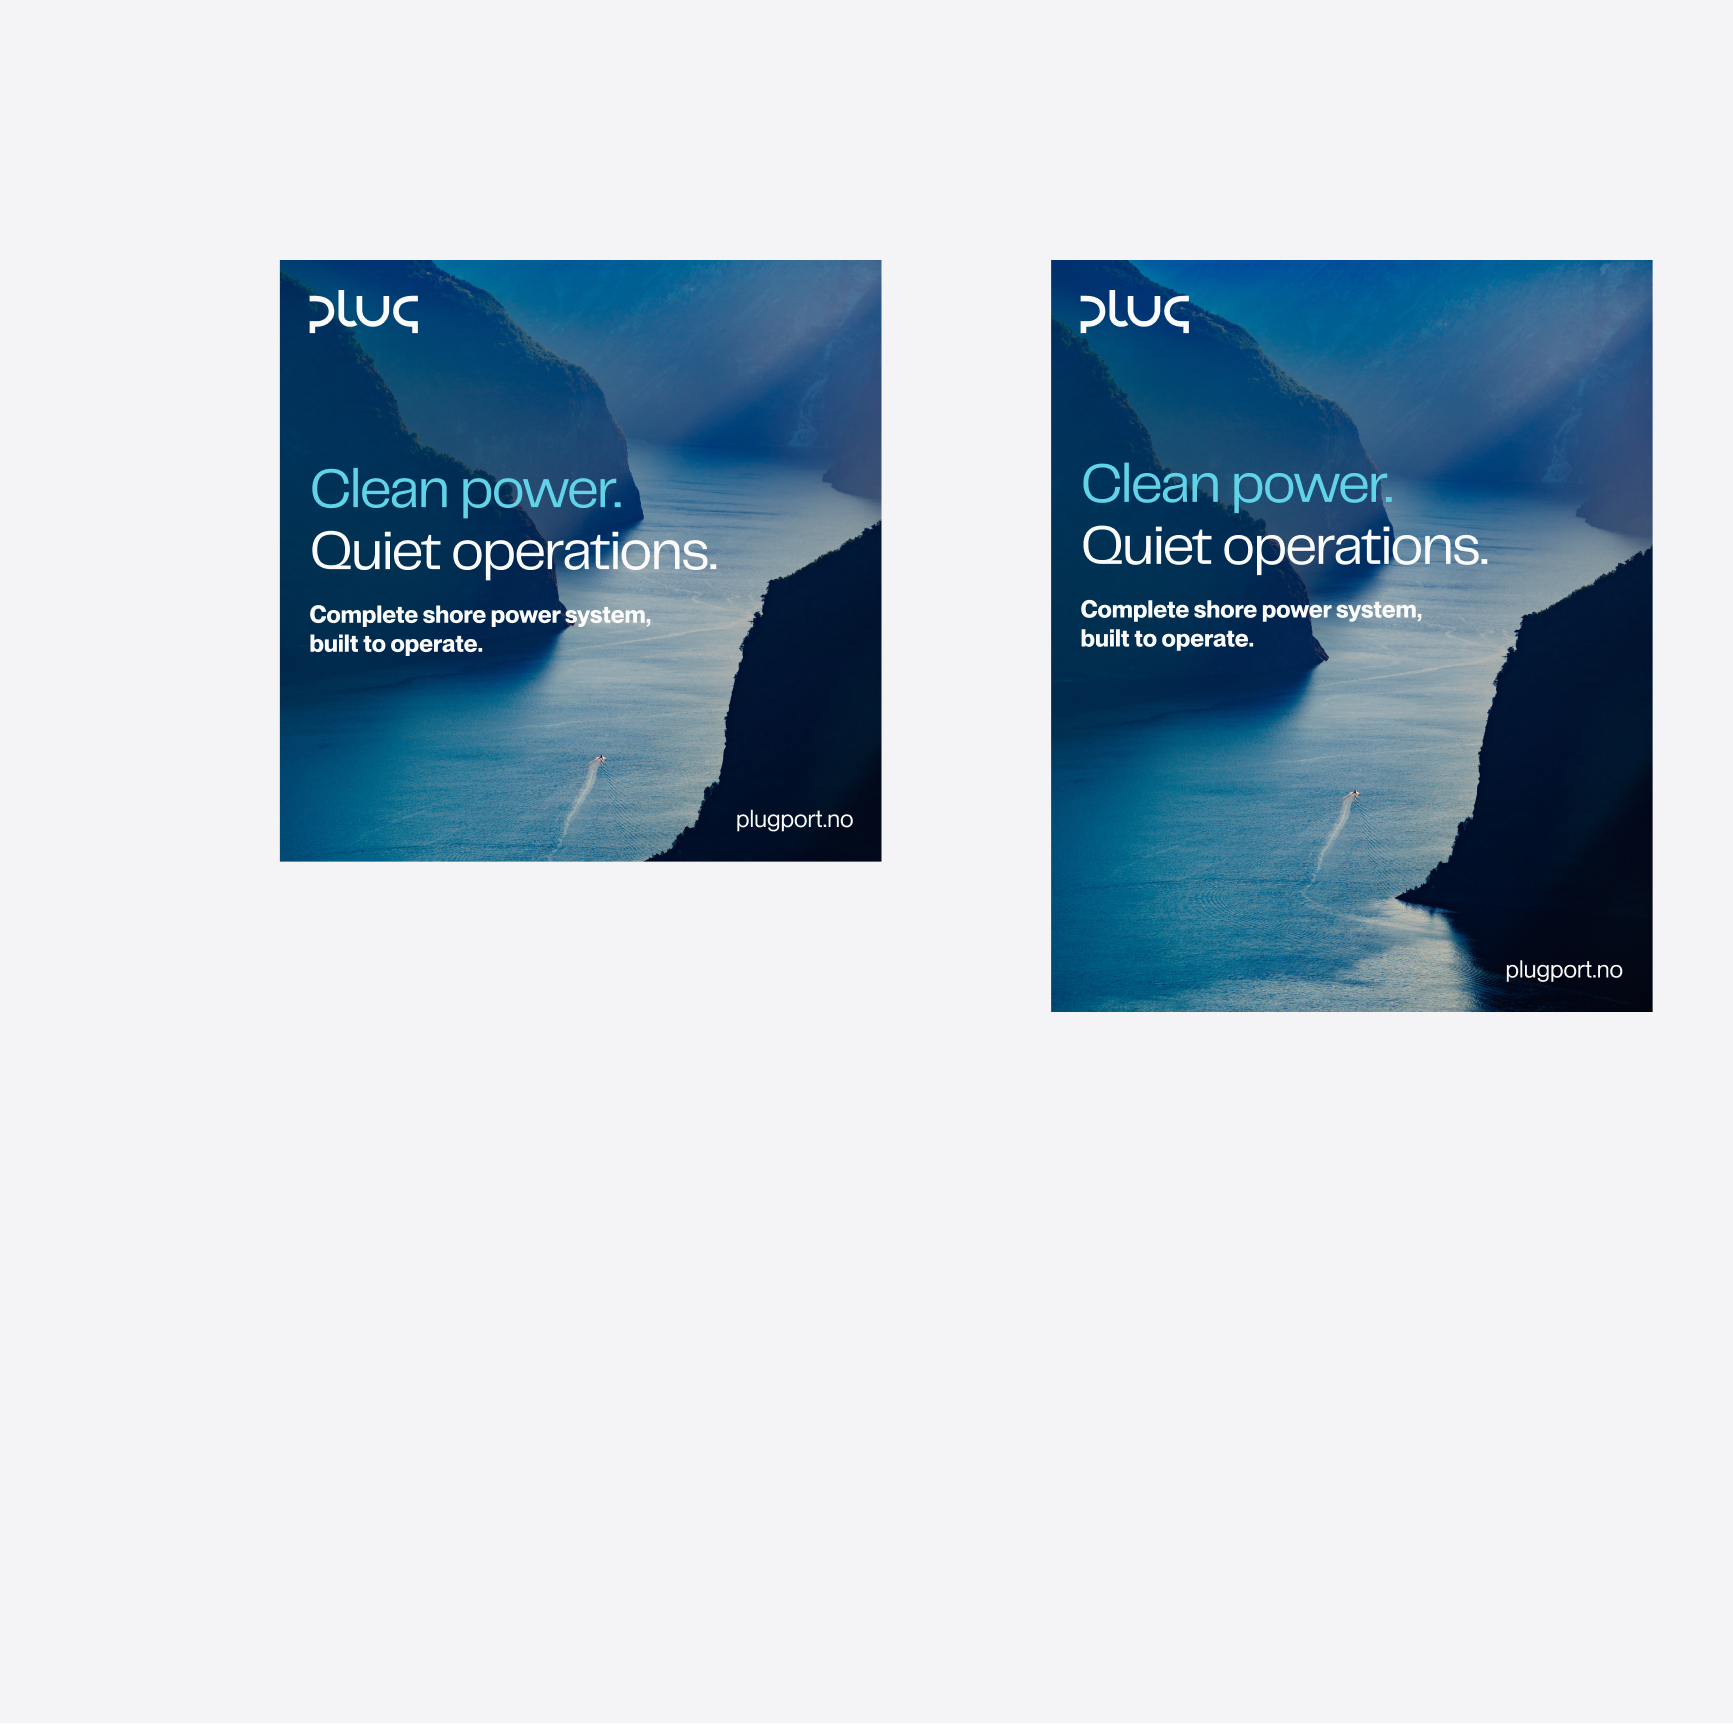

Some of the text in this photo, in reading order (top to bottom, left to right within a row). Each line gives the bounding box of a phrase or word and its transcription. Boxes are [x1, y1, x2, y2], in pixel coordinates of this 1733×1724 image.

[312, 467, 621, 519] Clean power.
[1083, 462, 1393, 514] Clean power.
[312, 530, 717, 581] Quiet operations.
[1083, 525, 1488, 576] Quiet operations.
[309, 604, 652, 628] Complete shore power system,
[1080, 599, 1423, 623] Complete shore power system,
[310, 634, 483, 657] built to operate.
[1081, 628, 1254, 652] built to operate.
[737, 809, 854, 832] plugport.no
[1506, 959, 1623, 983] plugport.no
